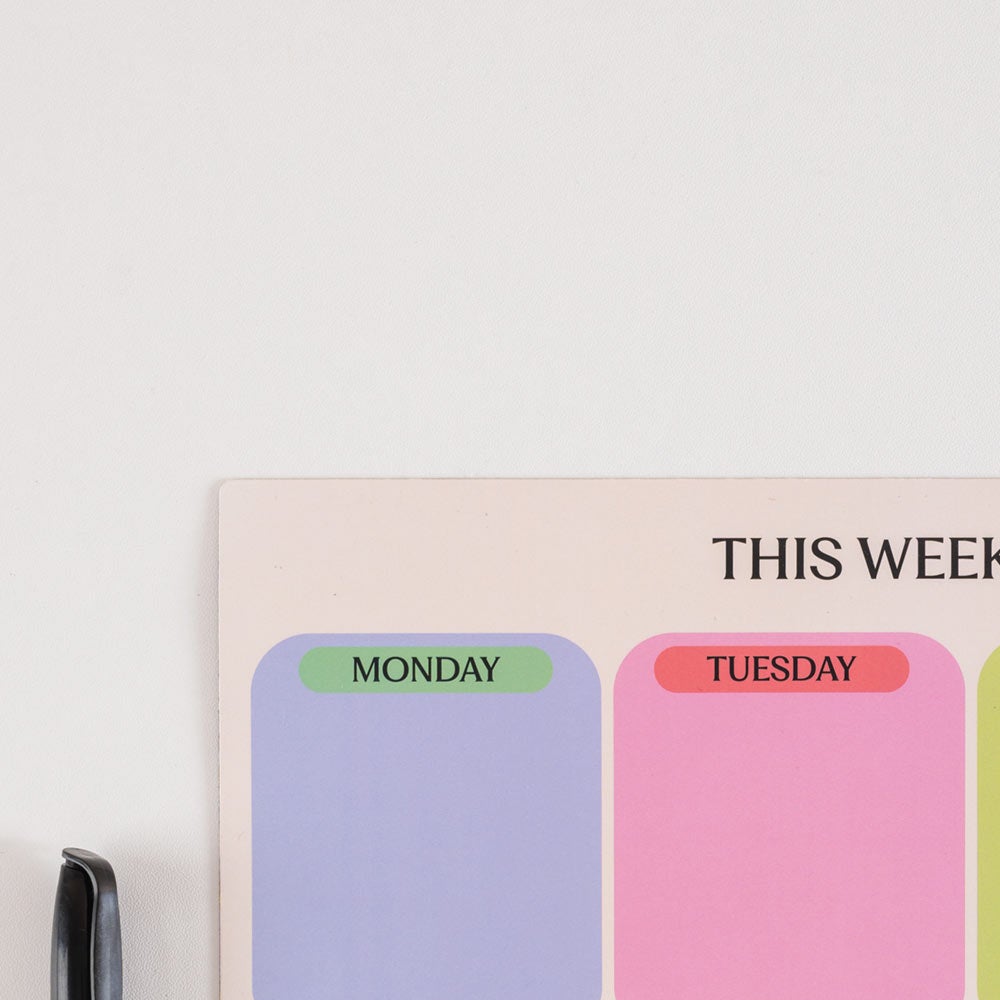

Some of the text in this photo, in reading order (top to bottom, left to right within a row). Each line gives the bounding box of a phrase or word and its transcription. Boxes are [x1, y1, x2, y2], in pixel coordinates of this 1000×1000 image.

[712, 536, 843, 581] THIS
[353, 656, 501, 683] MONDAY
[706, 655, 857, 682] TUESDAY
